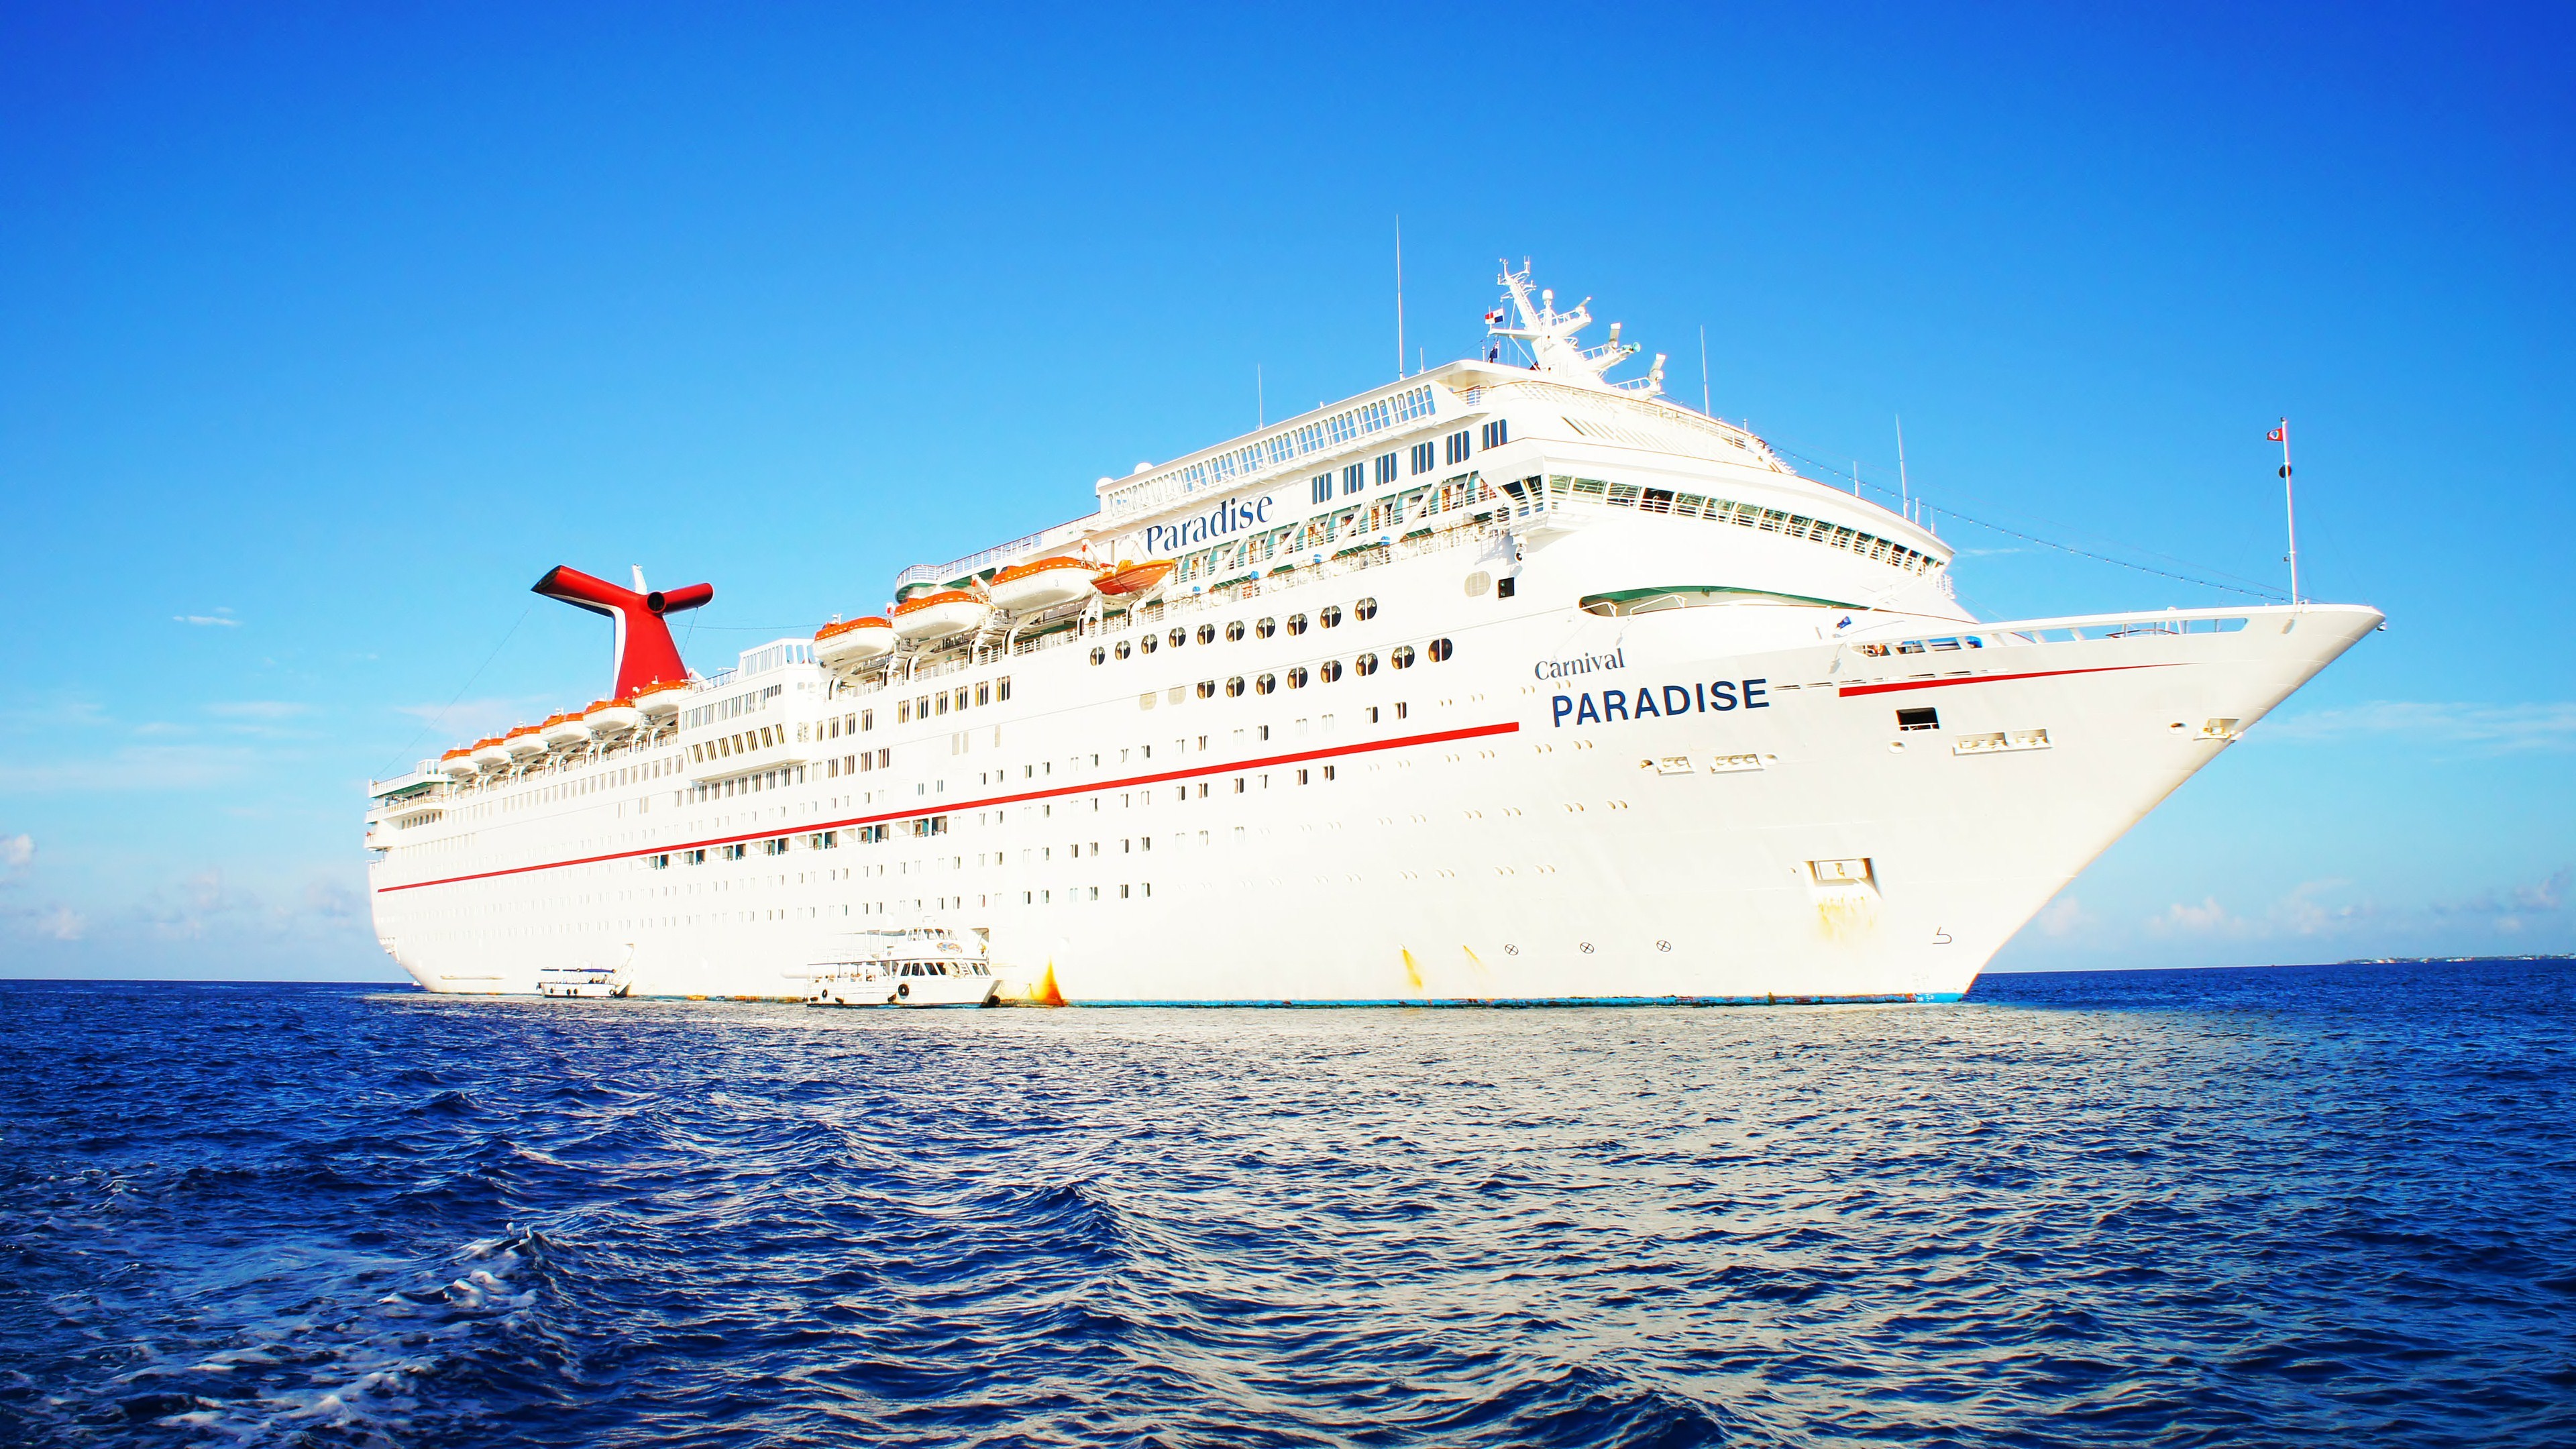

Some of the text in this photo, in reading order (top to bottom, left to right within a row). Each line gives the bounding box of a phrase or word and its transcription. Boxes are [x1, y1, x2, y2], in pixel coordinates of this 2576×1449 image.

[1146, 496, 1273, 555] Paradise
[1054, 579, 1059, 588] 3
[945, 612, 949, 620] 5
[1535, 648, 1625, 680] Carnival
[1552, 678, 1770, 728] PARADISE
